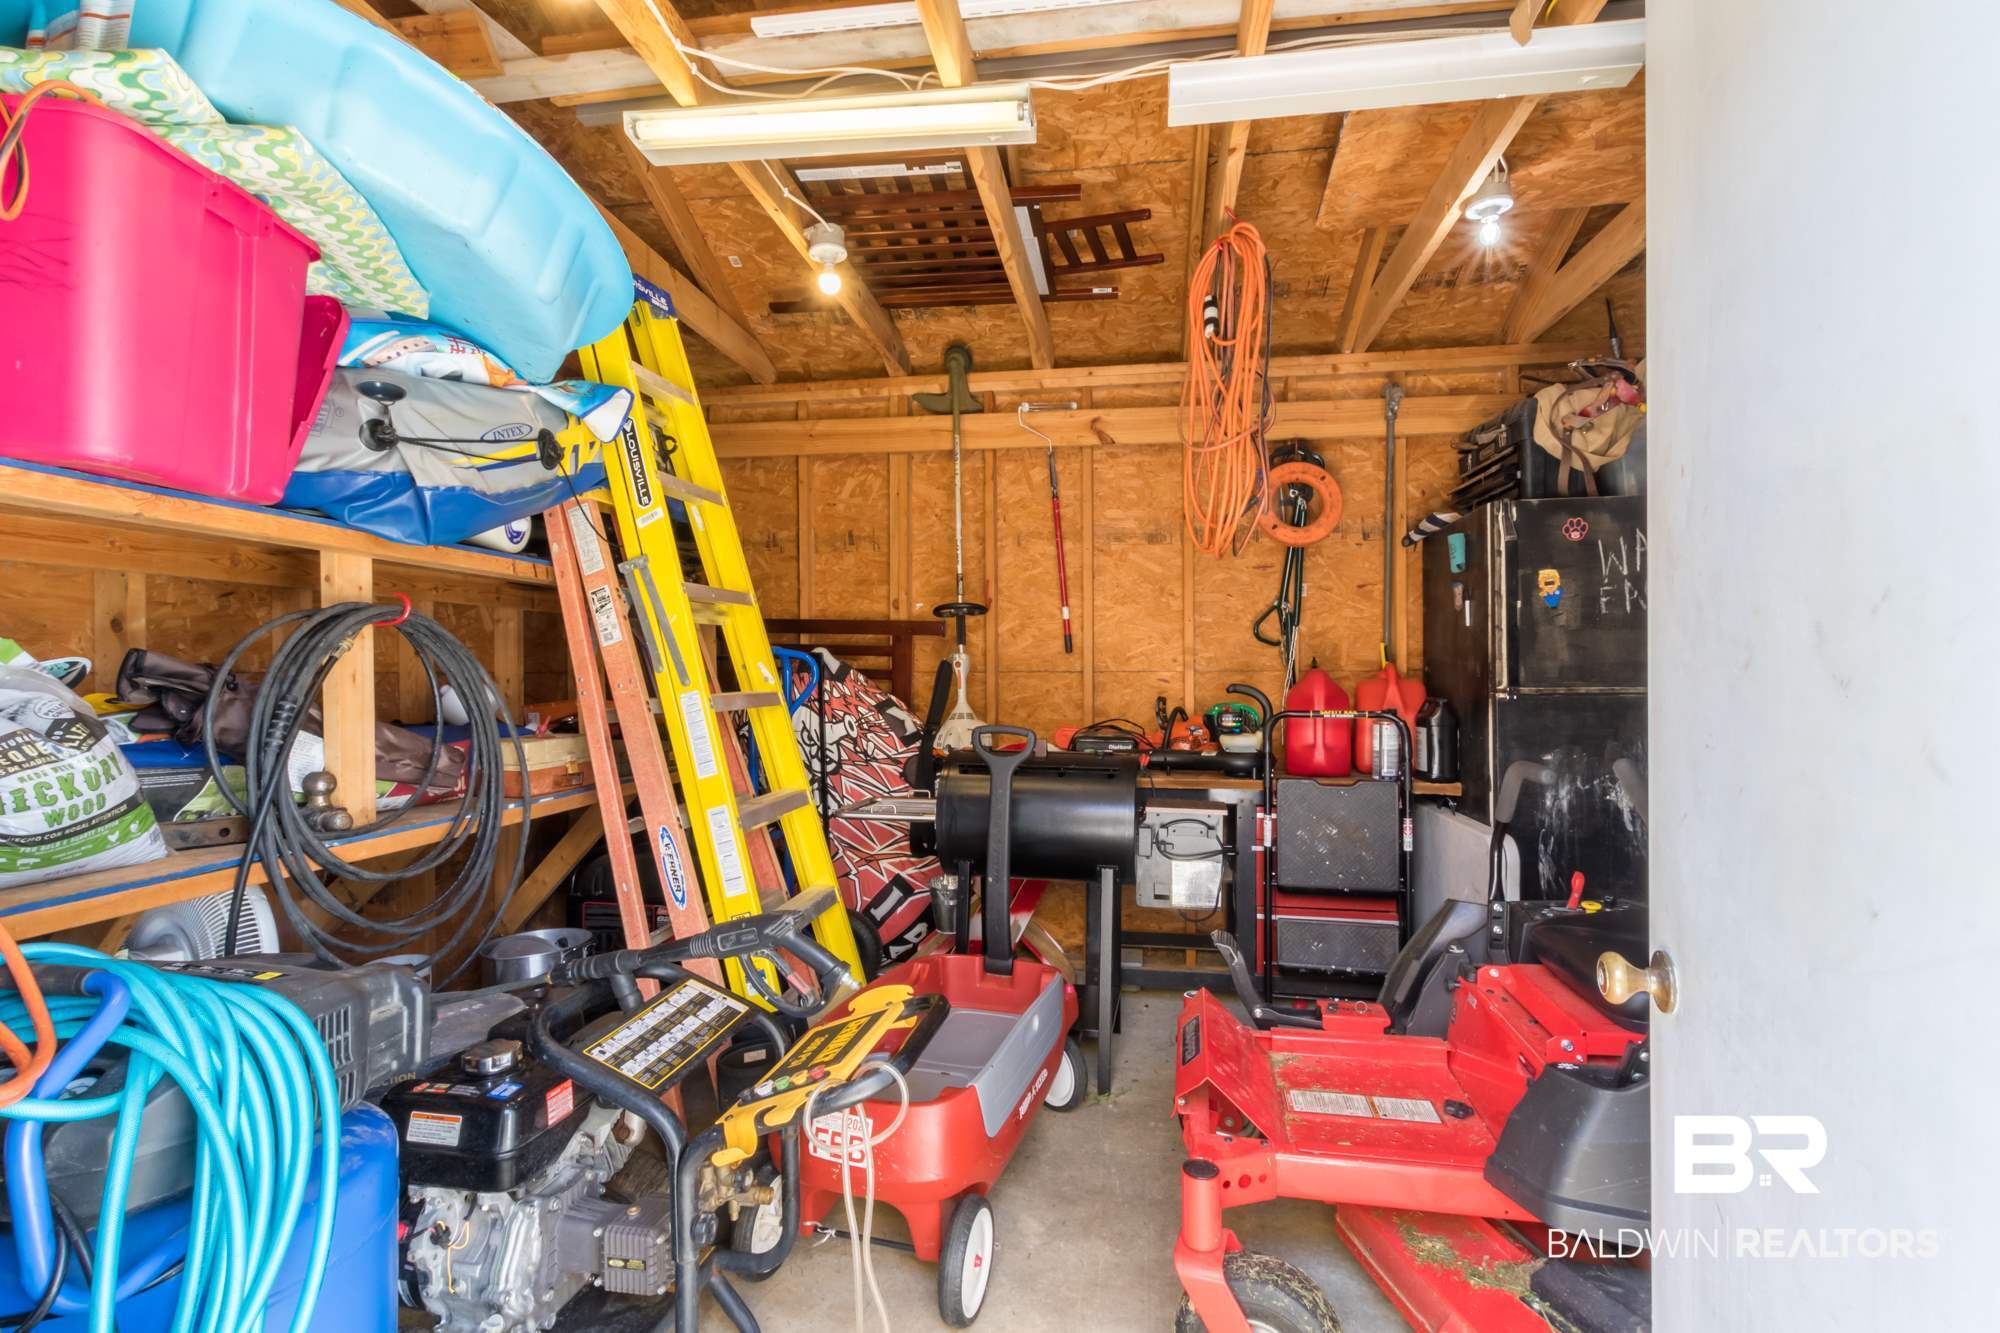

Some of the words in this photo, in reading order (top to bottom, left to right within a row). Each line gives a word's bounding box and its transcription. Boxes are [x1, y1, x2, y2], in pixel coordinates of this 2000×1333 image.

[493, 426, 525, 440] INTEX
[626, 431, 649, 506] LOUISVILLE
[1108, 743, 1132, 751] DieHard
[0, 751, 123, 816] ICKORY
[42, 793, 106, 828] WOOD
